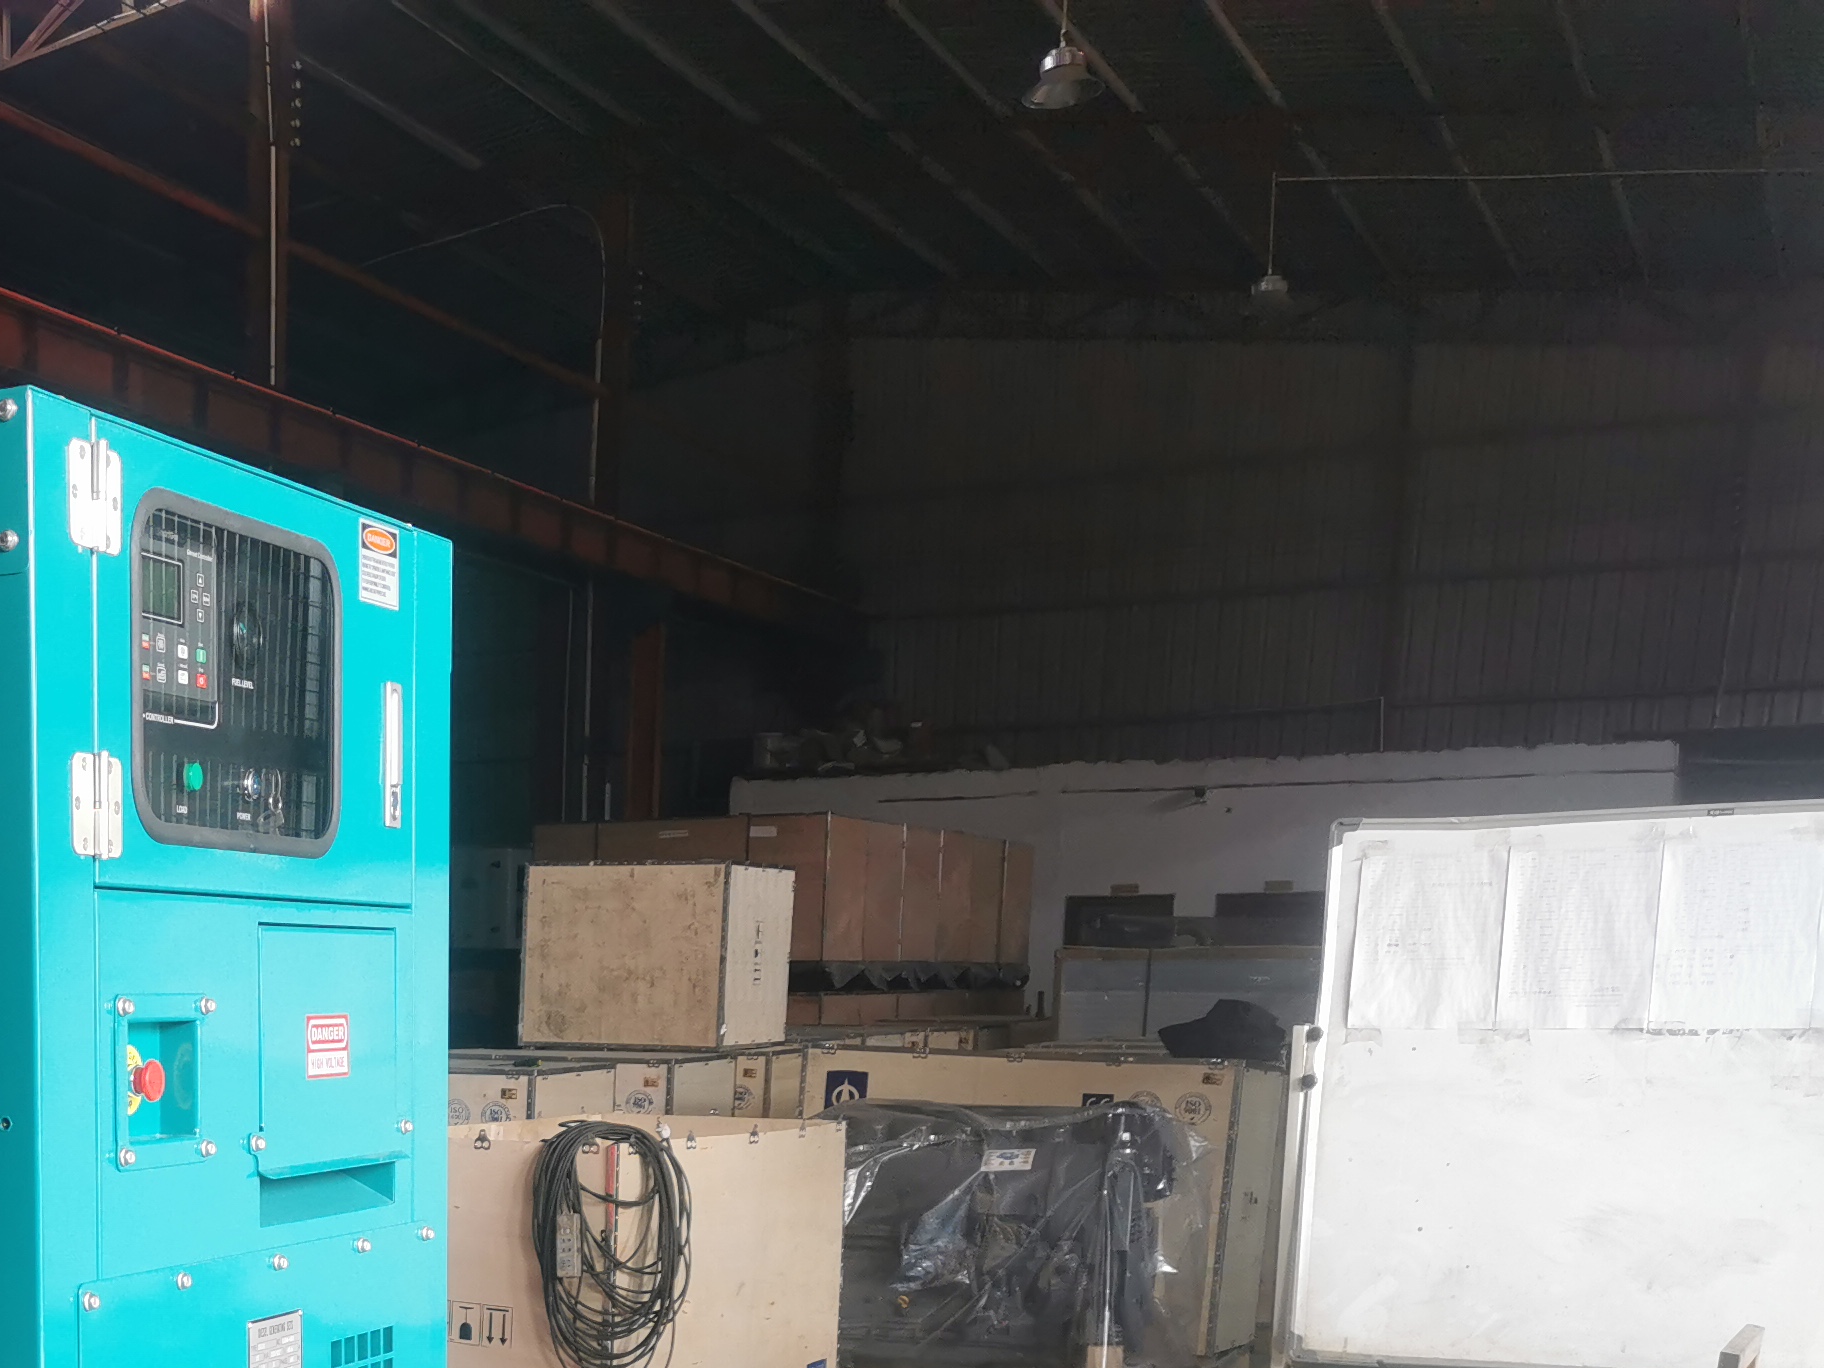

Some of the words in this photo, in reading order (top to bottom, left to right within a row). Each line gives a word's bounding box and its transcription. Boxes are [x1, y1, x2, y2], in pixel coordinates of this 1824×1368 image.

[367, 533, 391, 548] DANGER
[145, 712, 174, 724] CONTROLLER
[176, 805, 188, 814] LOAD
[237, 812, 251, 820] POWER
[311, 1026, 344, 1041] DANGER
[311, 1058, 324, 1069] HIGH
[325, 1056, 345, 1069] VOLTAGE
